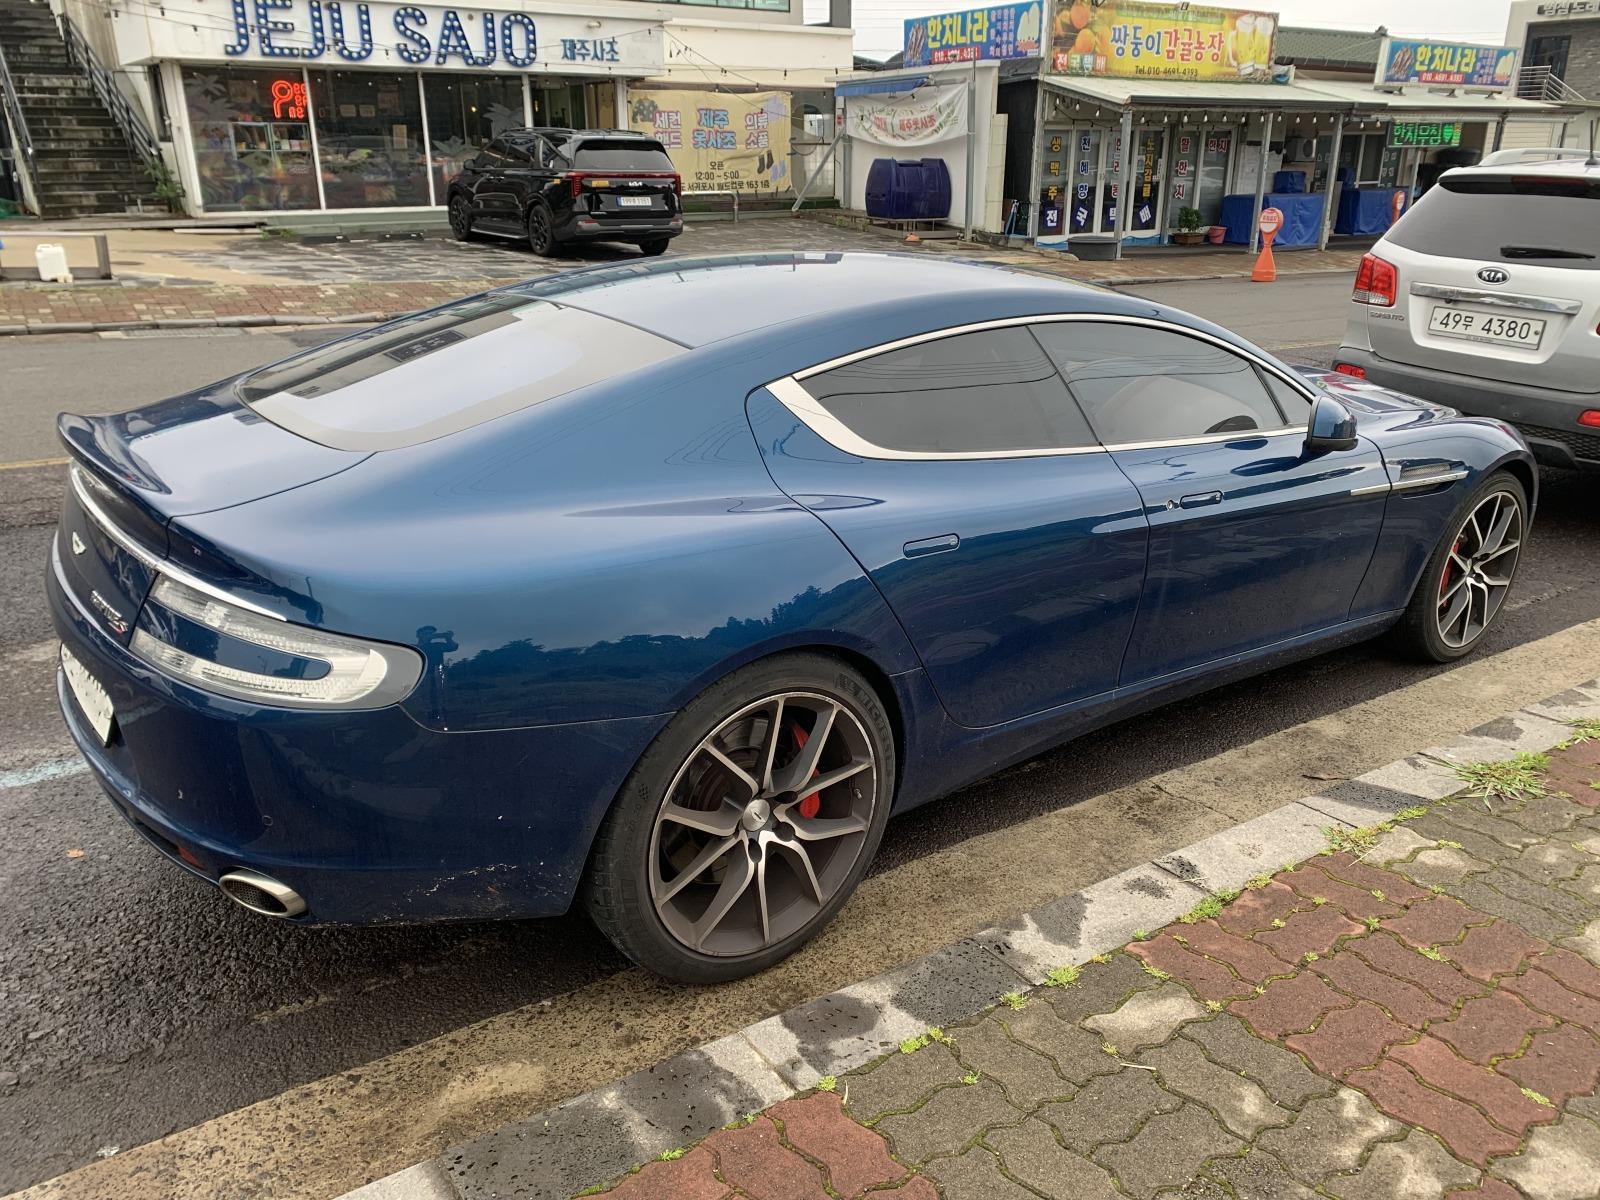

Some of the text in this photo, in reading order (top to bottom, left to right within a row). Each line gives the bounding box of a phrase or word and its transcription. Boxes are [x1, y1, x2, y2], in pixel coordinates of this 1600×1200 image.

[224, 0, 537, 67] JEJU SAJO
[927, 10, 989, 48] 한치나라
[1415, 45, 1476, 73] 한치나라
[655, 110, 681, 129] 세컨
[698, 109, 729, 128] 제주
[746, 131, 768, 149] 소품
[695, 171, 715, 180] 12:00
[723, 170, 740, 180] 5:00
[709, 161, 725, 170] 오픈
[1481, 269, 1504, 282] KIA
[1439, 311, 1474, 331] 49무
[1481, 317, 1531, 340] 4380
